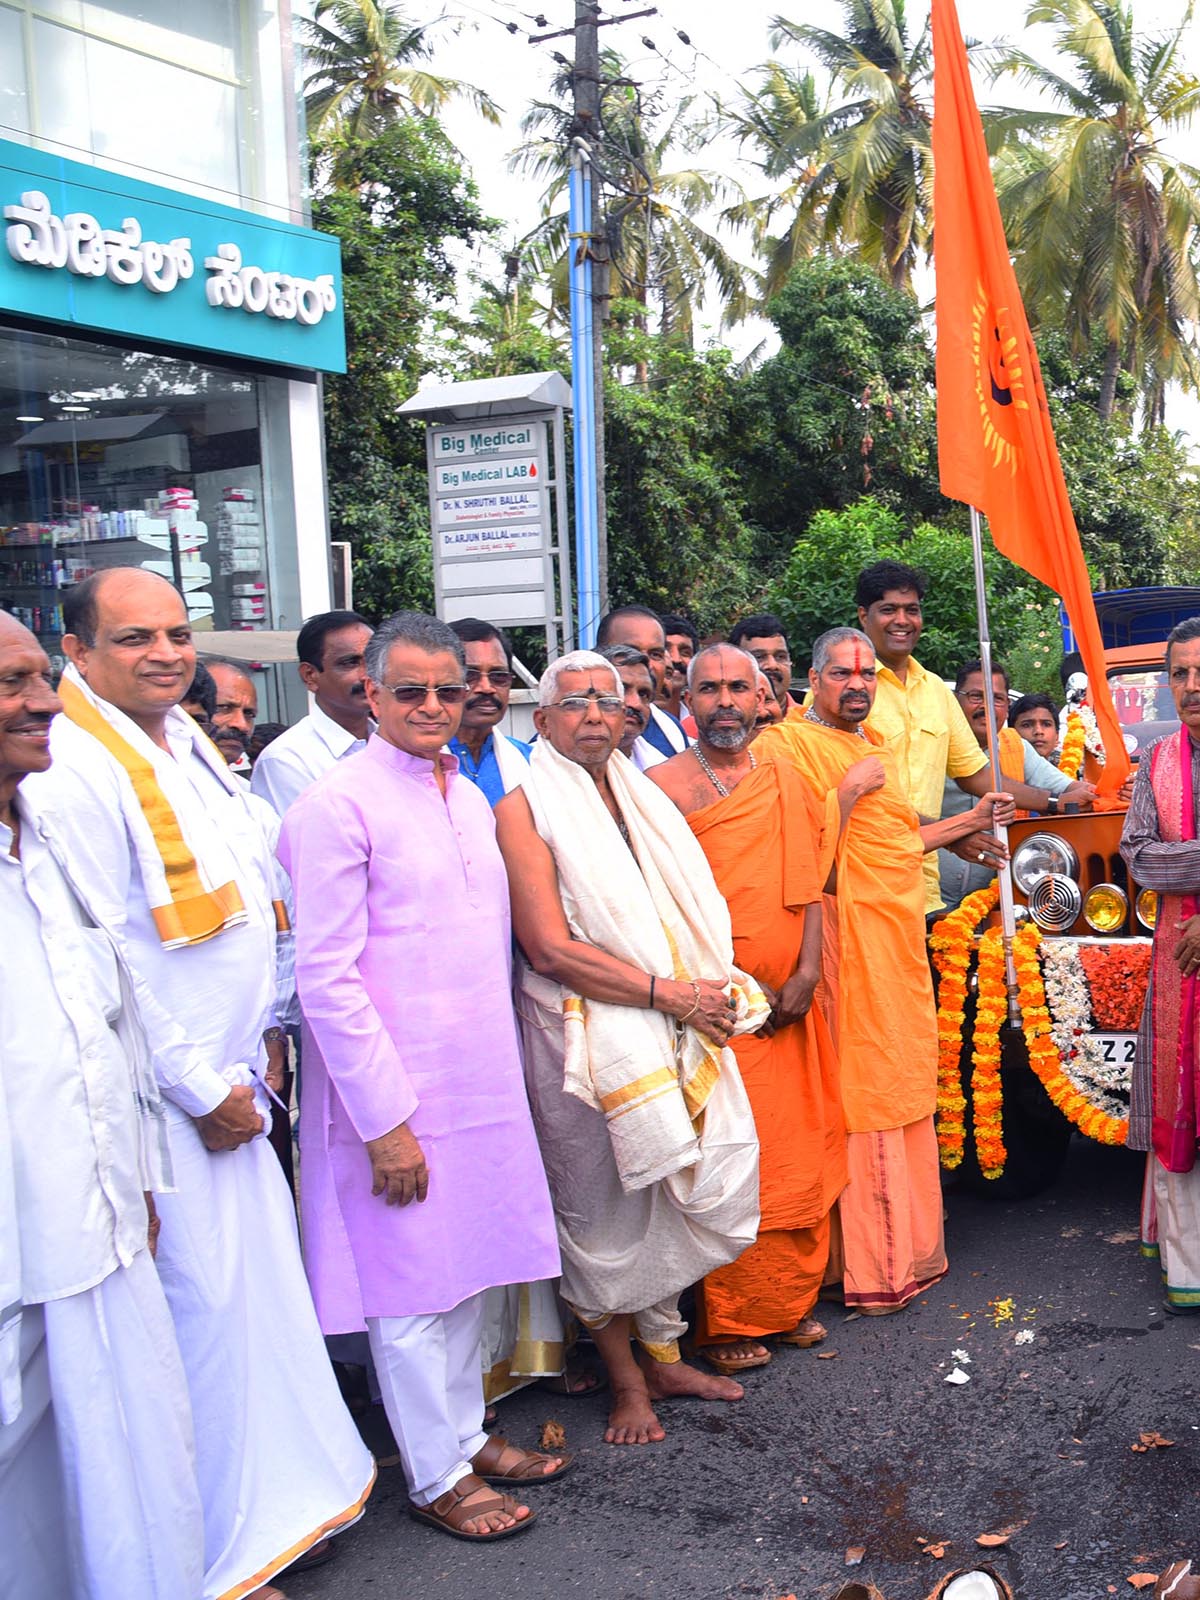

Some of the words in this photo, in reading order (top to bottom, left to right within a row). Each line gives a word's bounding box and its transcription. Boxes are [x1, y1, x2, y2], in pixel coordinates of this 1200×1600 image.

[204, 242, 337, 325] ಸೆಂಟರ್
[441, 436, 465, 453] Big
[470, 429, 530, 448] Medical
[442, 472, 459, 486] Big
[462, 467, 503, 482] Medical
[506, 465, 528, 478] LAB
[443, 501, 453, 510] Dr.
[464, 497, 497, 508] SHRUTHI
[500, 494, 529, 505] BALLAL
[455, 532, 480, 543] ARJUN
[481, 530, 510, 541] BALLAL
